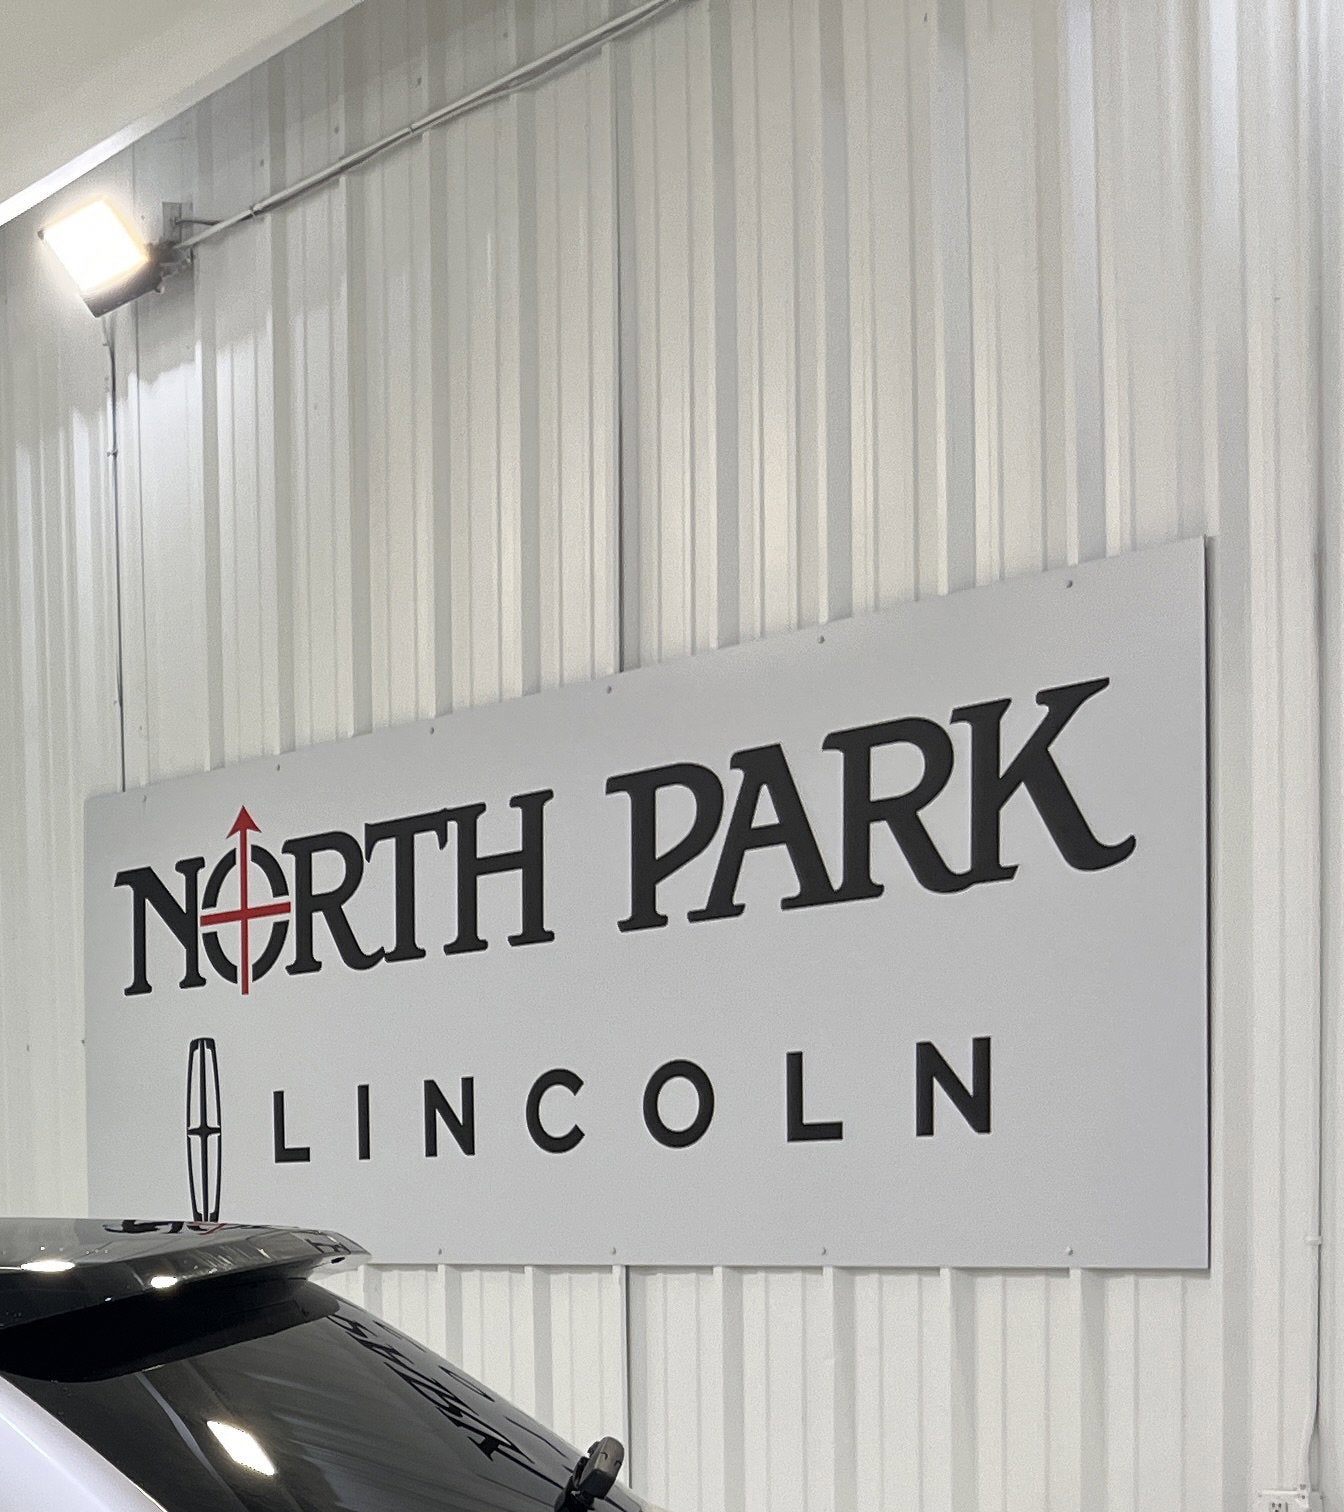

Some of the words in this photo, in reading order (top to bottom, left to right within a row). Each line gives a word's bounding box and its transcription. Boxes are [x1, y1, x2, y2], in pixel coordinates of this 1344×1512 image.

[113, 788, 556, 997] NORTH
[605, 677, 1137, 933] PARK
[273, 1036, 992, 1164] LINCOLN
